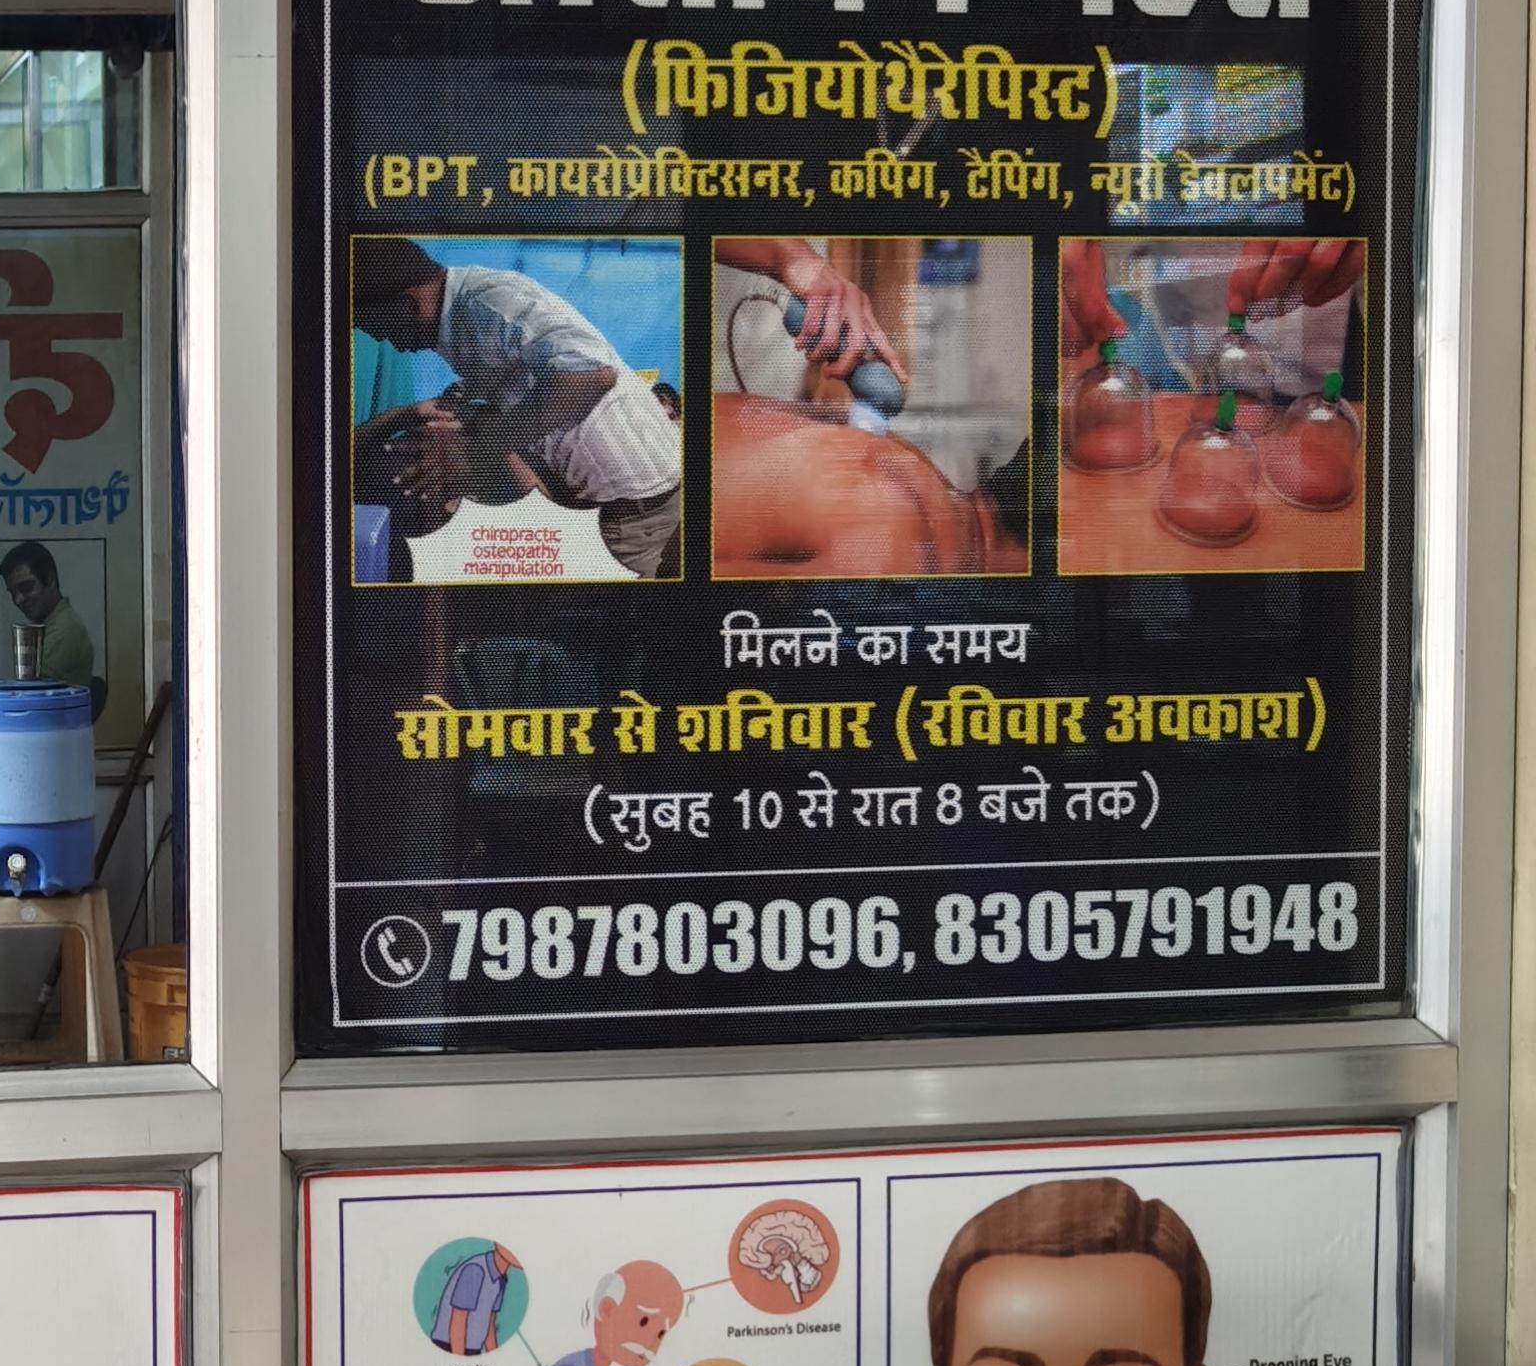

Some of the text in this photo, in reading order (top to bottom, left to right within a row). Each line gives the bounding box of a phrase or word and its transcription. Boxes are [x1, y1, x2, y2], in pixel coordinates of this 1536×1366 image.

[471, 525, 563, 545] chiropractic
[473, 543, 561, 563] osteopathy
[463, 561, 565, 579] manipulation
[720, 608, 1032, 668] मिलने का समय
[395, 677, 1327, 763] सोमवार से शनिवार (रविवार अवकाश)
[583, 764, 1161, 854] (सुबह 10 से रात 8 बजे तक)
[442, 881, 1360, 982] 7987803096, 8305791948
[796, 1320, 842, 1335] Disease
